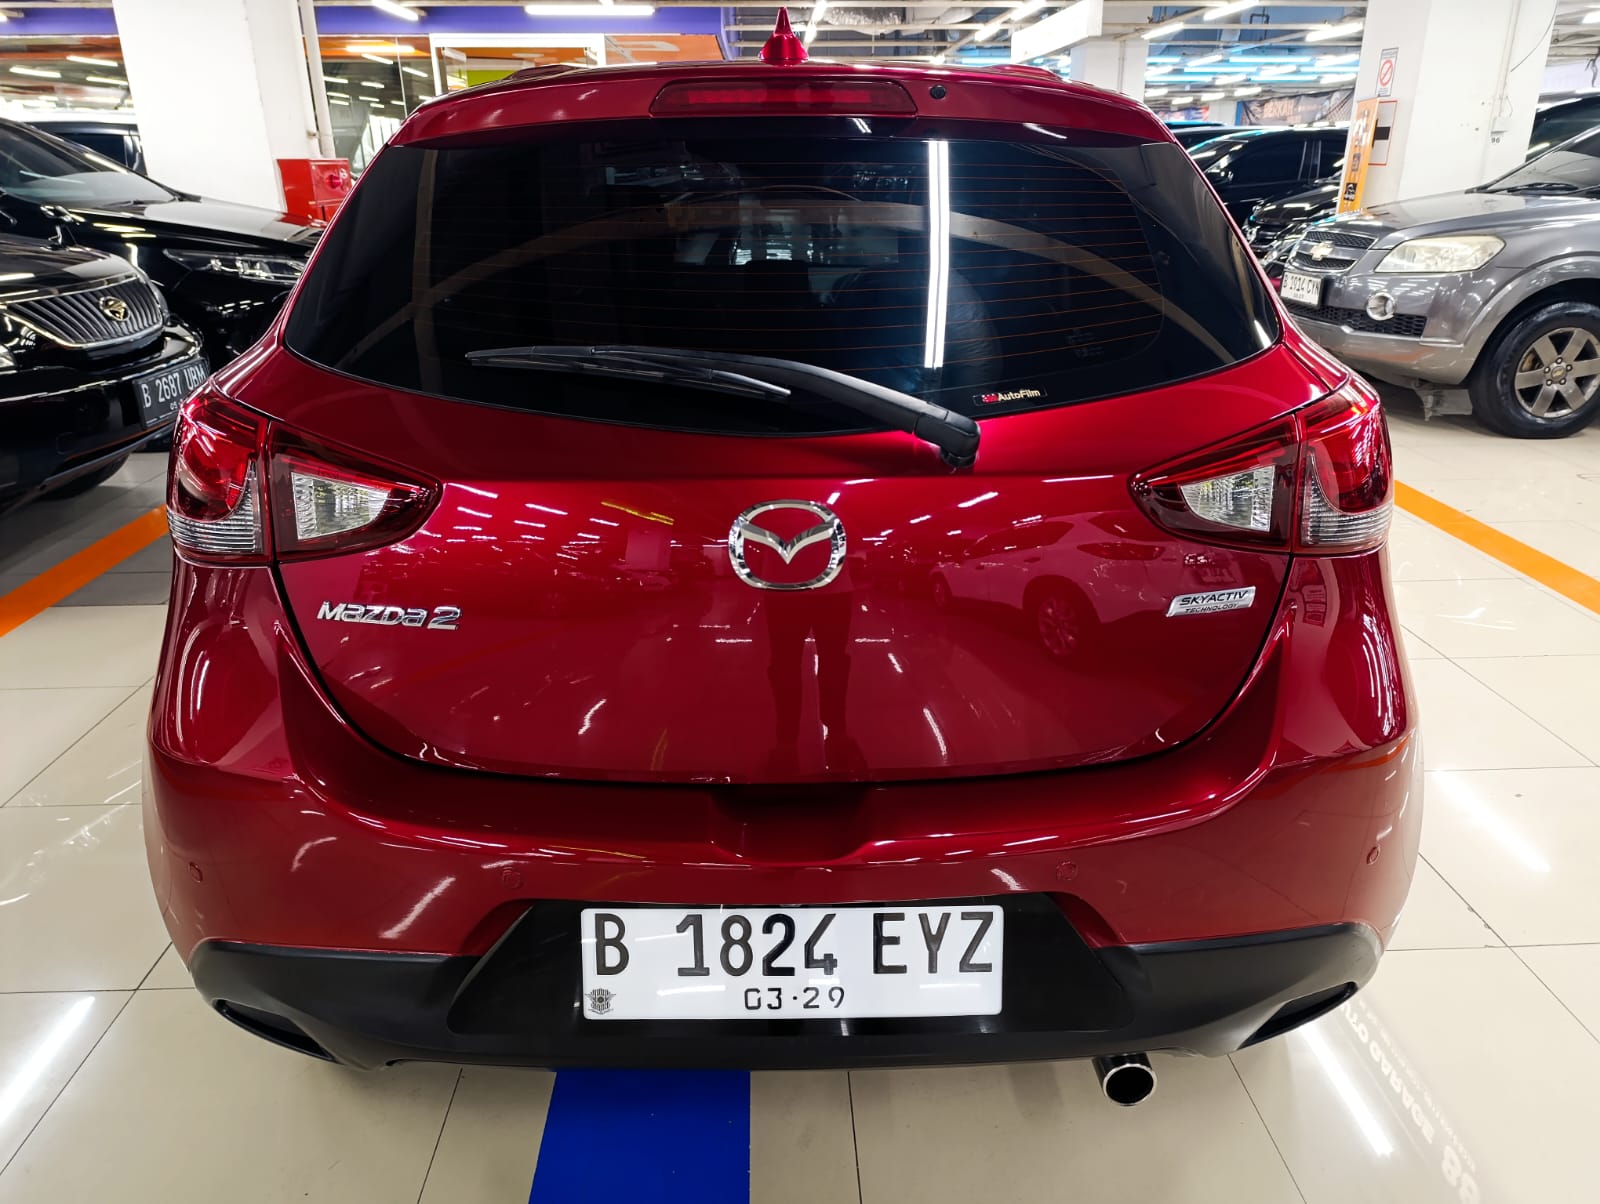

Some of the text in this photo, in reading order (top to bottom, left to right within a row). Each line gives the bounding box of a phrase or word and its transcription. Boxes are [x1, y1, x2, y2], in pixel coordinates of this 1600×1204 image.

[1283, 274, 1289, 288] B
[141, 364, 206, 408] B 2687 UBM
[998, 389, 1041, 402] AutoFilm
[1180, 590, 1248, 605] SKYACTIV
[1184, 603, 1238, 614] TECHNOLOGY
[594, 911, 994, 977] B 1824 EYZ
